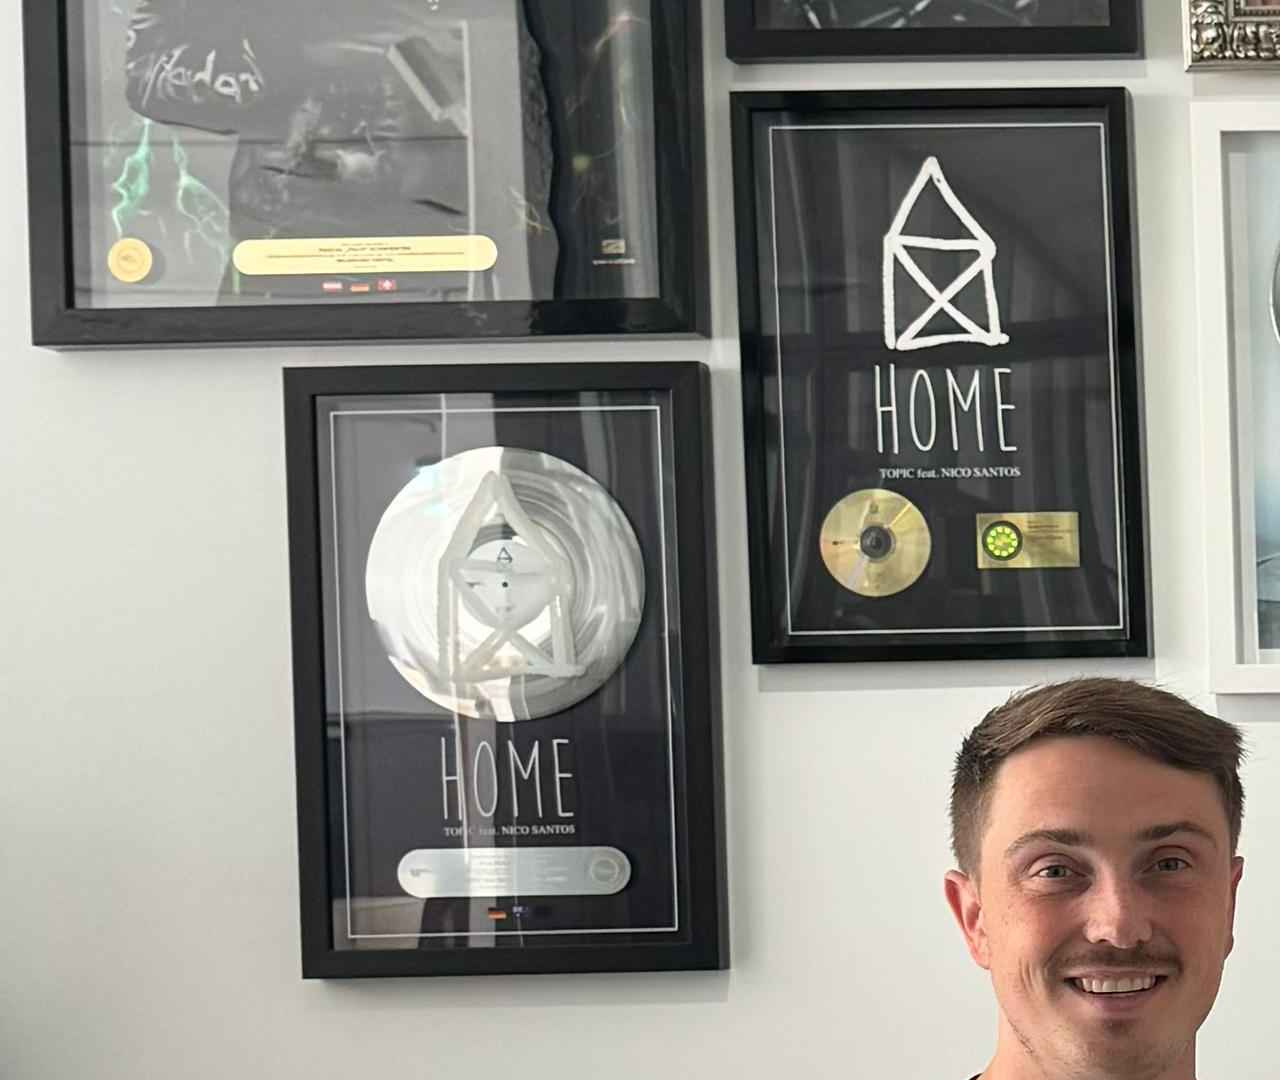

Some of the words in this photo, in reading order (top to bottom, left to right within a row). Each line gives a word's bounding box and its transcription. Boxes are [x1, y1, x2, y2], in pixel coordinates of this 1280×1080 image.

[874, 363, 1017, 455] HOME
[879, 468, 914, 480] TOPIC
[941, 468, 972, 479] NICO
[973, 466, 1021, 478] SANTOS
[441, 736, 574, 821] HOME
[502, 825, 530, 835] NICO
[531, 824, 575, 834] SANTOS
